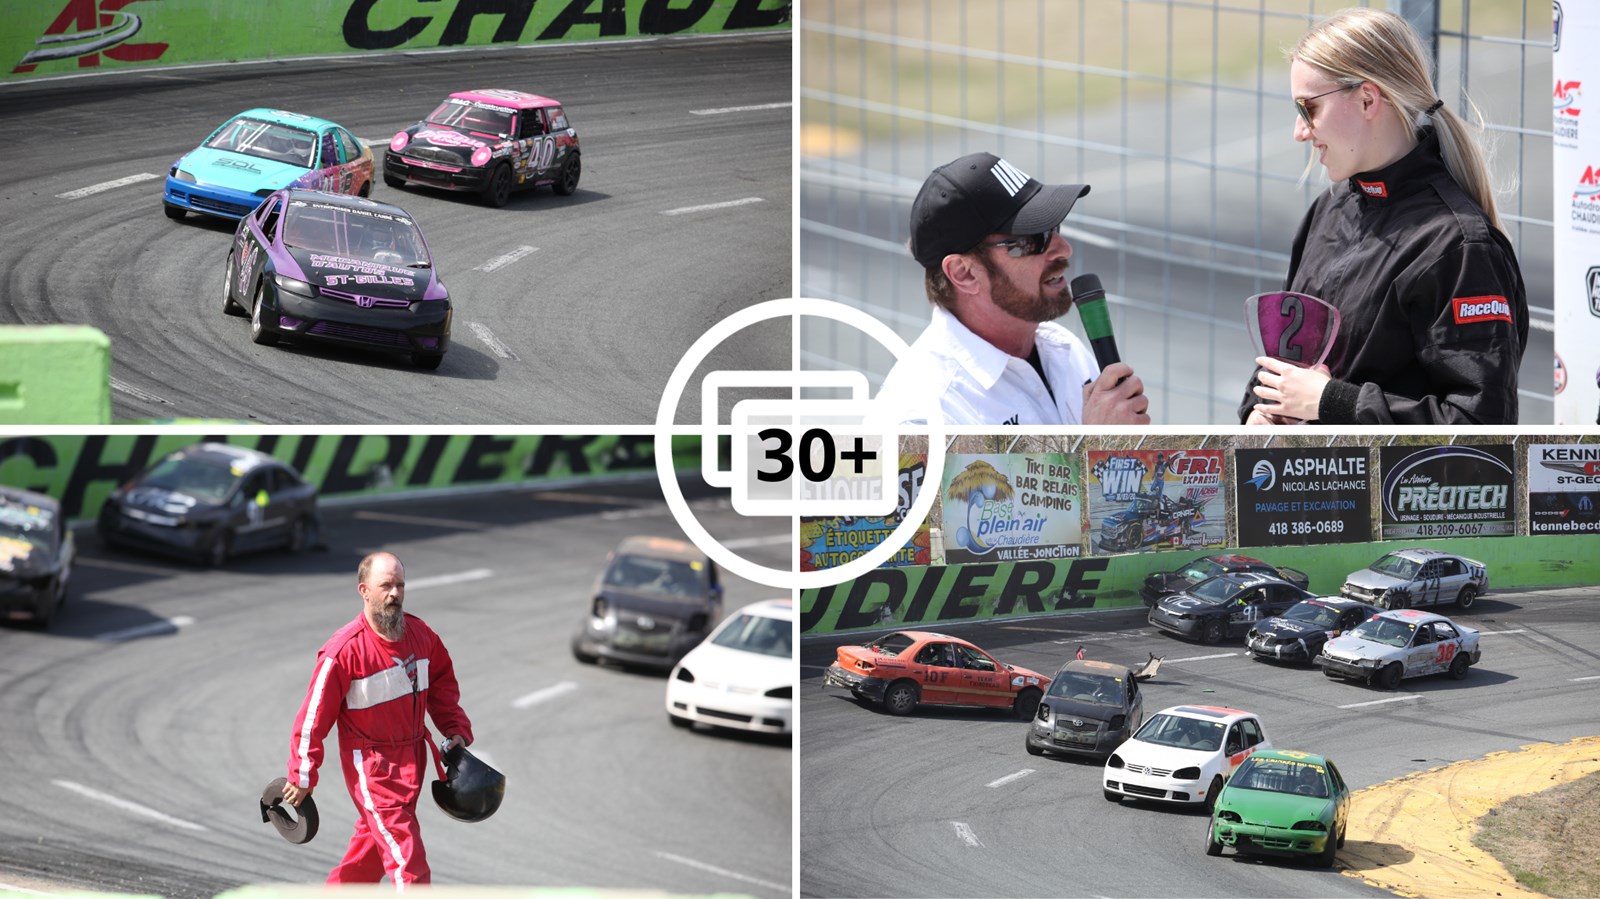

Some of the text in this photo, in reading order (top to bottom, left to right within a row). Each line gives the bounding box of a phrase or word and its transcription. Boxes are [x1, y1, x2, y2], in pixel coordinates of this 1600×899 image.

[324, 275, 415, 286] ST-GILLES
[1278, 296, 1304, 361] 2
[1110, 456, 1137, 469] FIRST
[1542, 449, 1600, 460] KENN
[1048, 464, 1071, 479] BAR
[1177, 458, 1220, 475] FRL
[1282, 457, 1366, 476] ASPHALTE
[1016, 475, 1078, 496] BAR RELAIS
[1103, 470, 1142, 494] WIN
[1282, 480, 1367, 492] NICOLAS LACHANCE
[1021, 492, 1072, 511] CAMPING
[1397, 482, 1508, 512] PRÉCITECH
[980, 501, 1014, 521] Base
[1255, 500, 1356, 513] PAVAGE ET EXCAVATION
[977, 513, 1048, 538] plein air
[1269, 520, 1344, 535] 418 386-0689
[1417, 523, 1483, 536] 418-209-6067
[997, 534, 1040, 546] Chaudière
